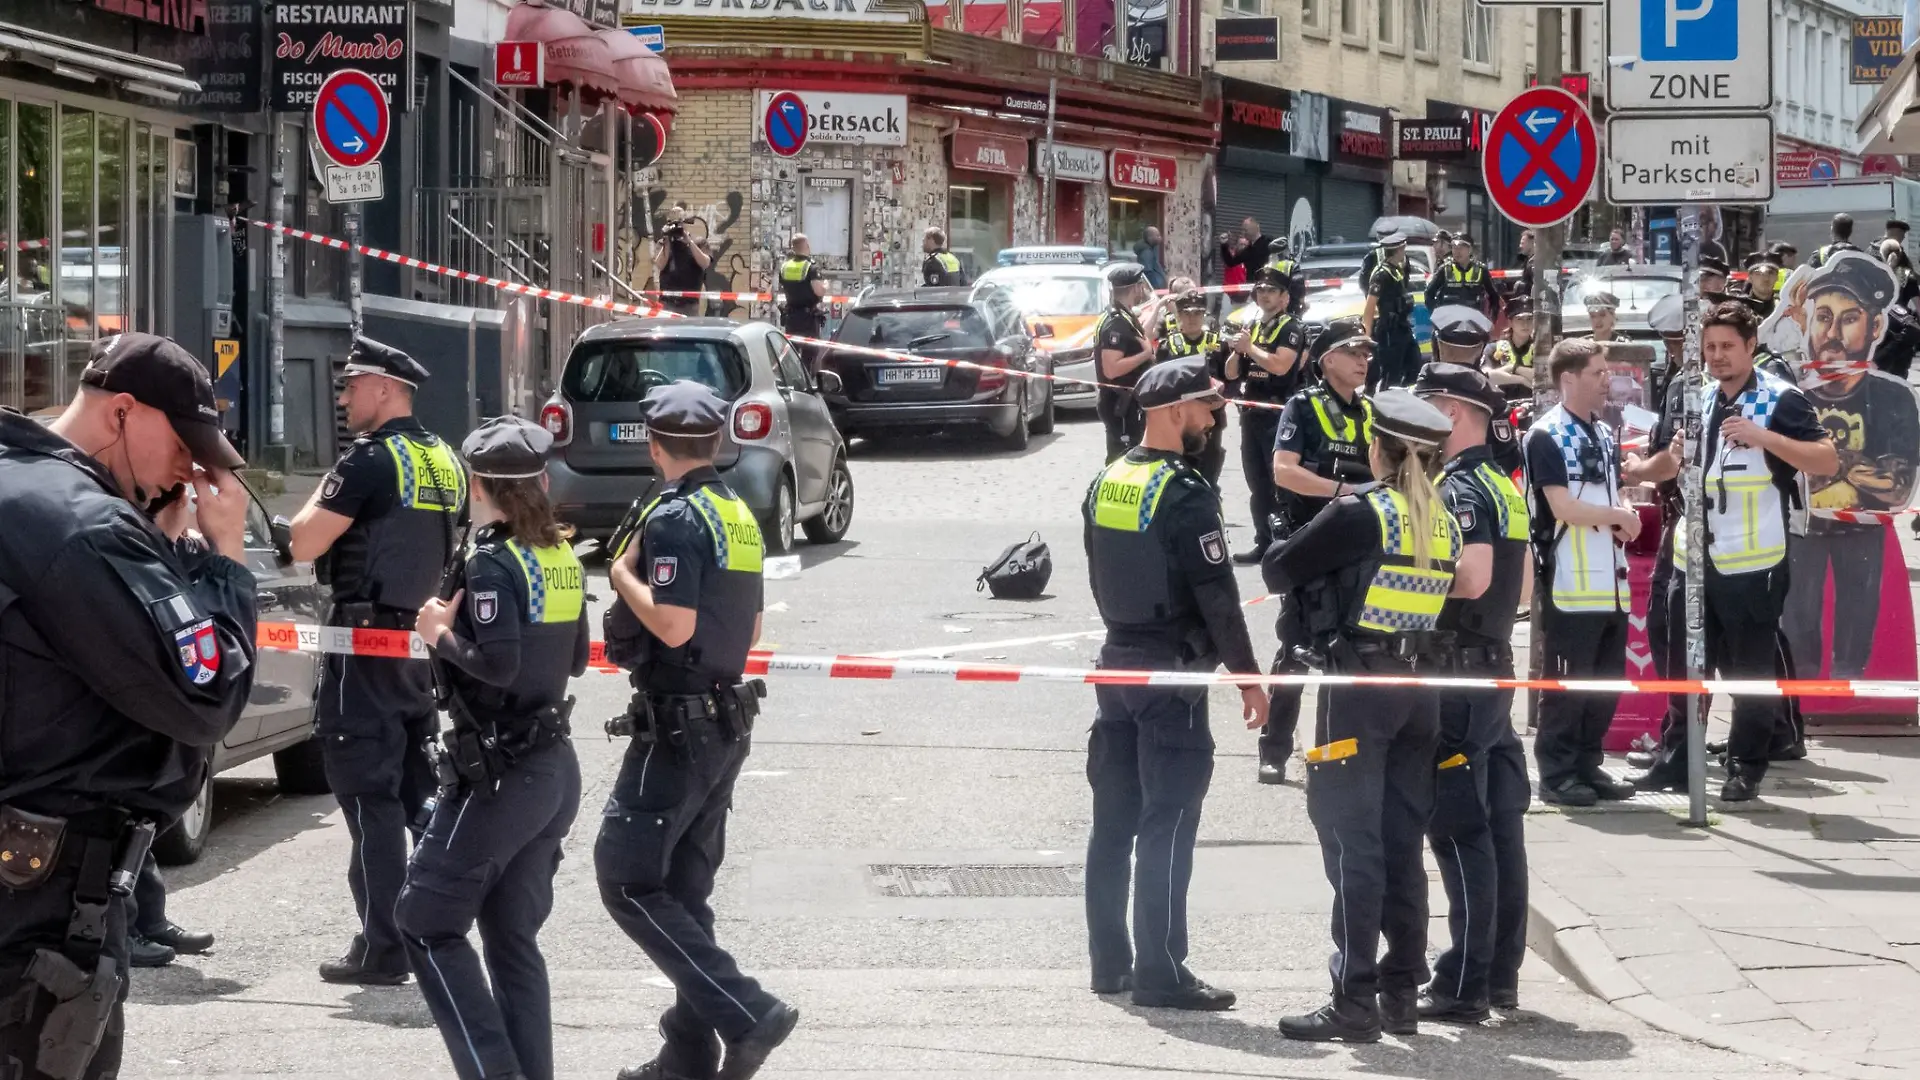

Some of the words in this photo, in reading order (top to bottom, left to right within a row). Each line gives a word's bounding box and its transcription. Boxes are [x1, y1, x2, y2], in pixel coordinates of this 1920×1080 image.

[276, 5, 405, 24] RESTAURANT
[276, 32, 305, 58] do
[305, 31, 403, 64] Mundo
[1855, 66, 1877, 78] Tax
[1650, 74, 1731, 99] ZONE
[1006, 96, 1047, 111] Querstraße
[1403, 127, 1417, 140] ST.
[1424, 127, 1461, 140] PAULI
[1671, 135, 1710, 155] mit
[977, 147, 1006, 166] ASTRA
[1131, 166, 1160, 185] ASTRA
[1622, 163, 1760, 184] Parkschen
[1020, 251, 1080, 259] FEUERWEHR
[220, 344, 234, 355] ATM
[619, 425, 636, 438] HH
[1101, 481, 1141, 506] POLIZEI
[1402, 514, 1449, 539] PZEI
[200, 671, 211, 680] SH
